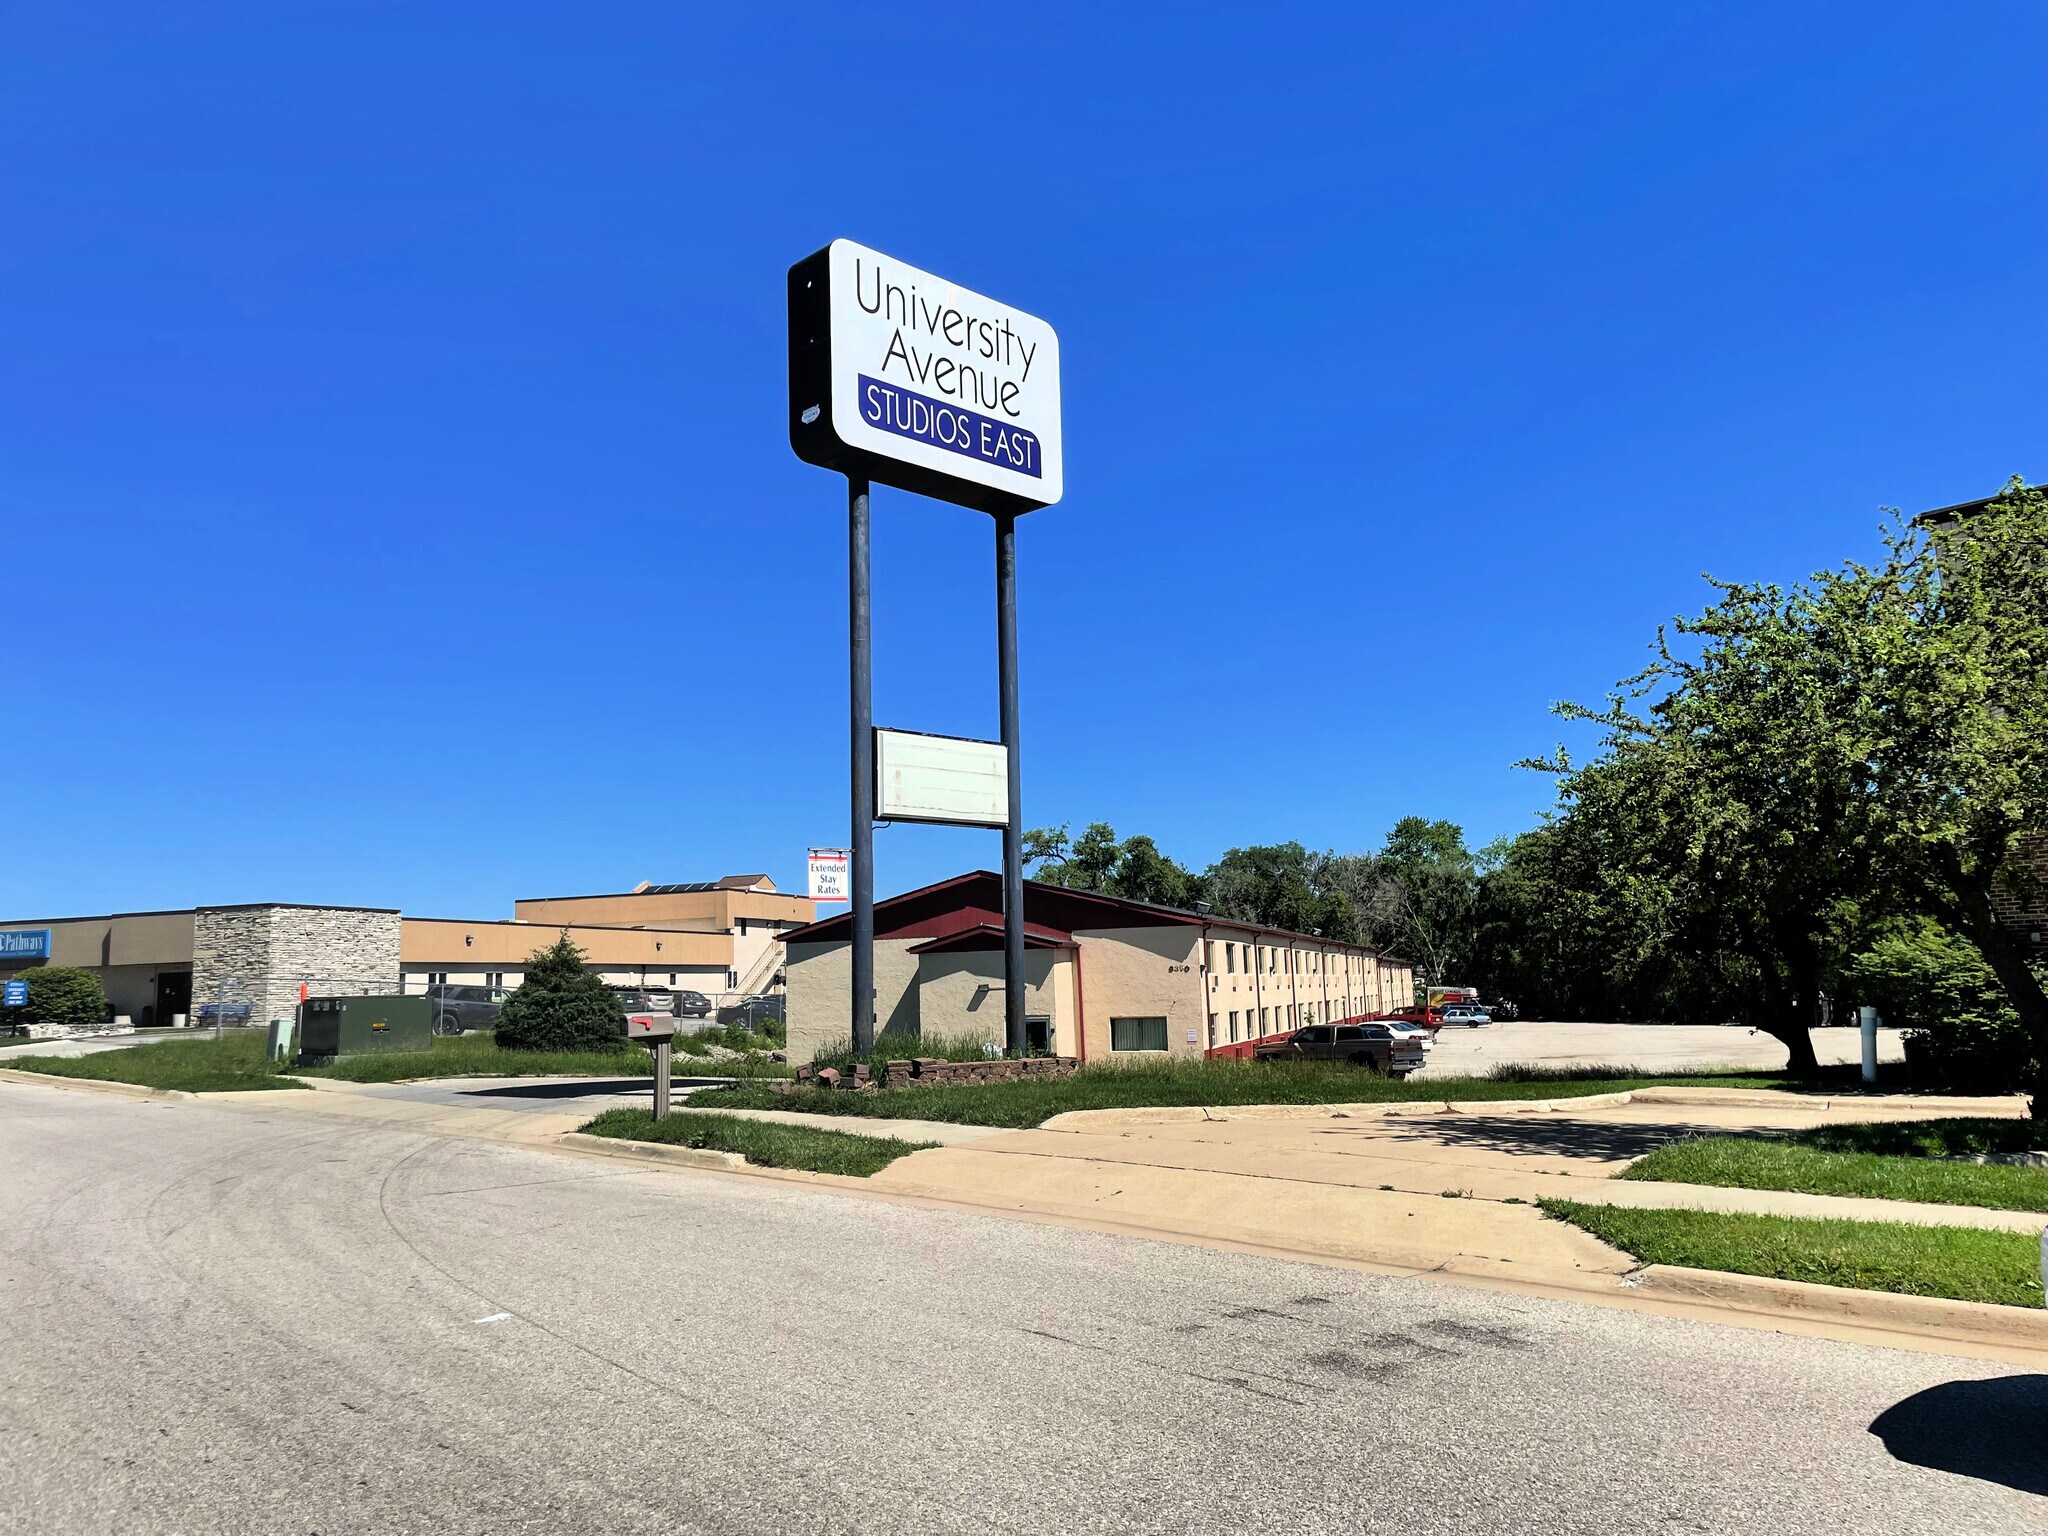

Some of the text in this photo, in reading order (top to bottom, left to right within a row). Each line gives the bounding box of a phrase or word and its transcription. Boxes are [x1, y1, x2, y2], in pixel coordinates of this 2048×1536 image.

[856, 258, 1037, 383] University
[881, 327, 1021, 417] Avenue
[866, 384, 1035, 469] STUDIOS EAST
[810, 863, 846, 873] Extended
[820, 874, 837, 885] Stay
[817, 885, 841, 894] Rates
[5, 933, 44, 951] Pathways
